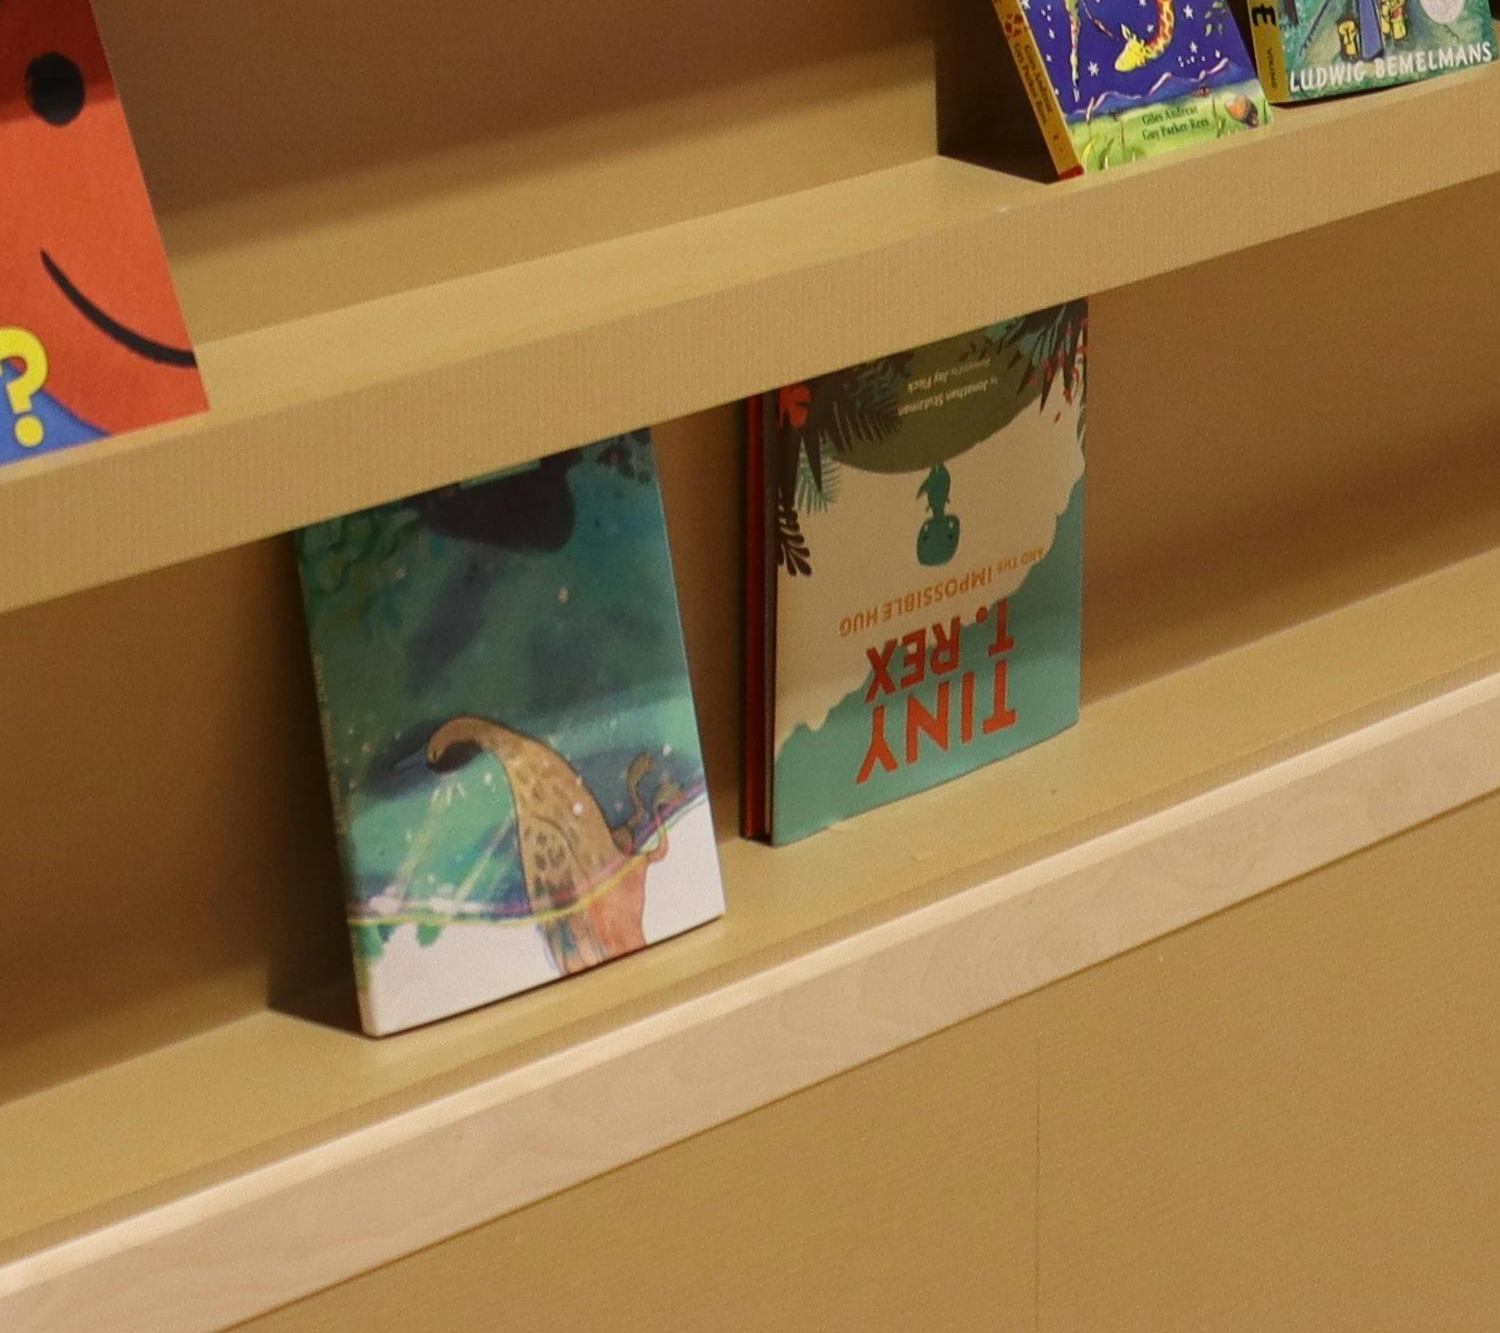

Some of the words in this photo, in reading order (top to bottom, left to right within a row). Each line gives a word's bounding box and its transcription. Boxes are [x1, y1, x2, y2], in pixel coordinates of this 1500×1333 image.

[1288, 59, 1367, 94] LUDWIG
[1374, 39, 1495, 77] BEMELMANS
[838, 607, 879, 638] HUG
[880, 566, 993, 624] IMPOSSIBLE
[975, 598, 1015, 658] T.
[864, 616, 961, 704] REX
[855, 659, 1017, 785] TINY
